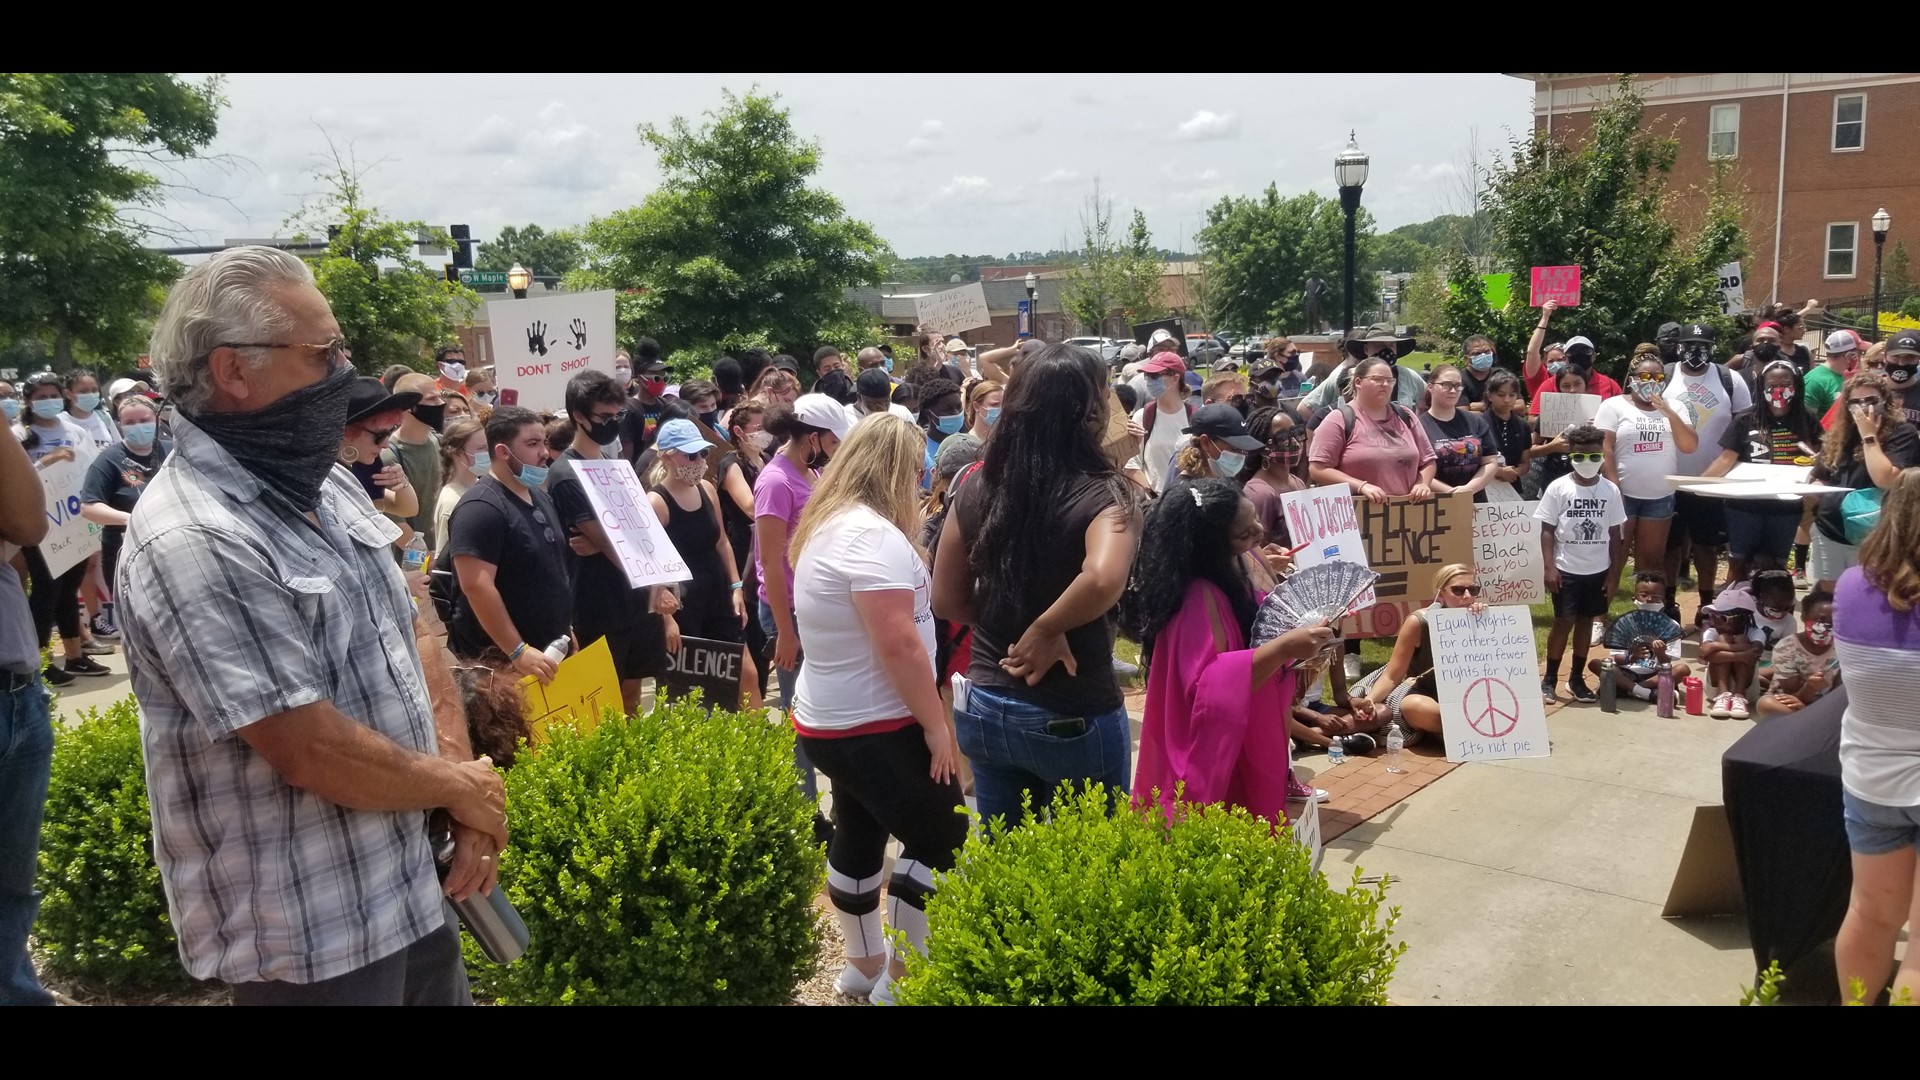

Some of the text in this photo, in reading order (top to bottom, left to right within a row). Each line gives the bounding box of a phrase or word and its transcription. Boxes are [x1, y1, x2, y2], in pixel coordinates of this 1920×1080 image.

[482, 274, 503, 283] Maple
[1540, 268, 1575, 280] BLACK
[1535, 279, 1568, 292] LIVES
[517, 356, 591, 377] DONT SHOOT
[1544, 394, 1582, 411] BLACK
[1552, 410, 1575, 421] LIVES
[1636, 422, 1658, 430] COLOR
[1640, 431, 1662, 442] NOT
[1642, 442, 1662, 451] CRIME
[45, 463, 88, 496] ilence
[582, 467, 638, 486] TEACH
[598, 488, 648, 508] YOUR
[1574, 498, 1608, 510] CAN'T
[602, 507, 651, 530] CHILD
[1287, 500, 1315, 543] NO
[1487, 505, 1530, 522] Black
[1472, 522, 1531, 538] SEE YOU
[1482, 542, 1530, 560] Black
[1474, 558, 1529, 576] Hear YOU
[1495, 579, 1534, 594] STAND
[1488, 589, 1538, 604] WITH YOU
[1435, 612, 1472, 636] Equal
[1475, 614, 1516, 634] Rights
[1439, 633, 1530, 650] for others does
[666, 646, 741, 681] SILENCE
[1441, 648, 1528, 665] not mean fewer
[1442, 663, 1528, 683] rights for you
[1458, 738, 1531, 758] It's not pie
